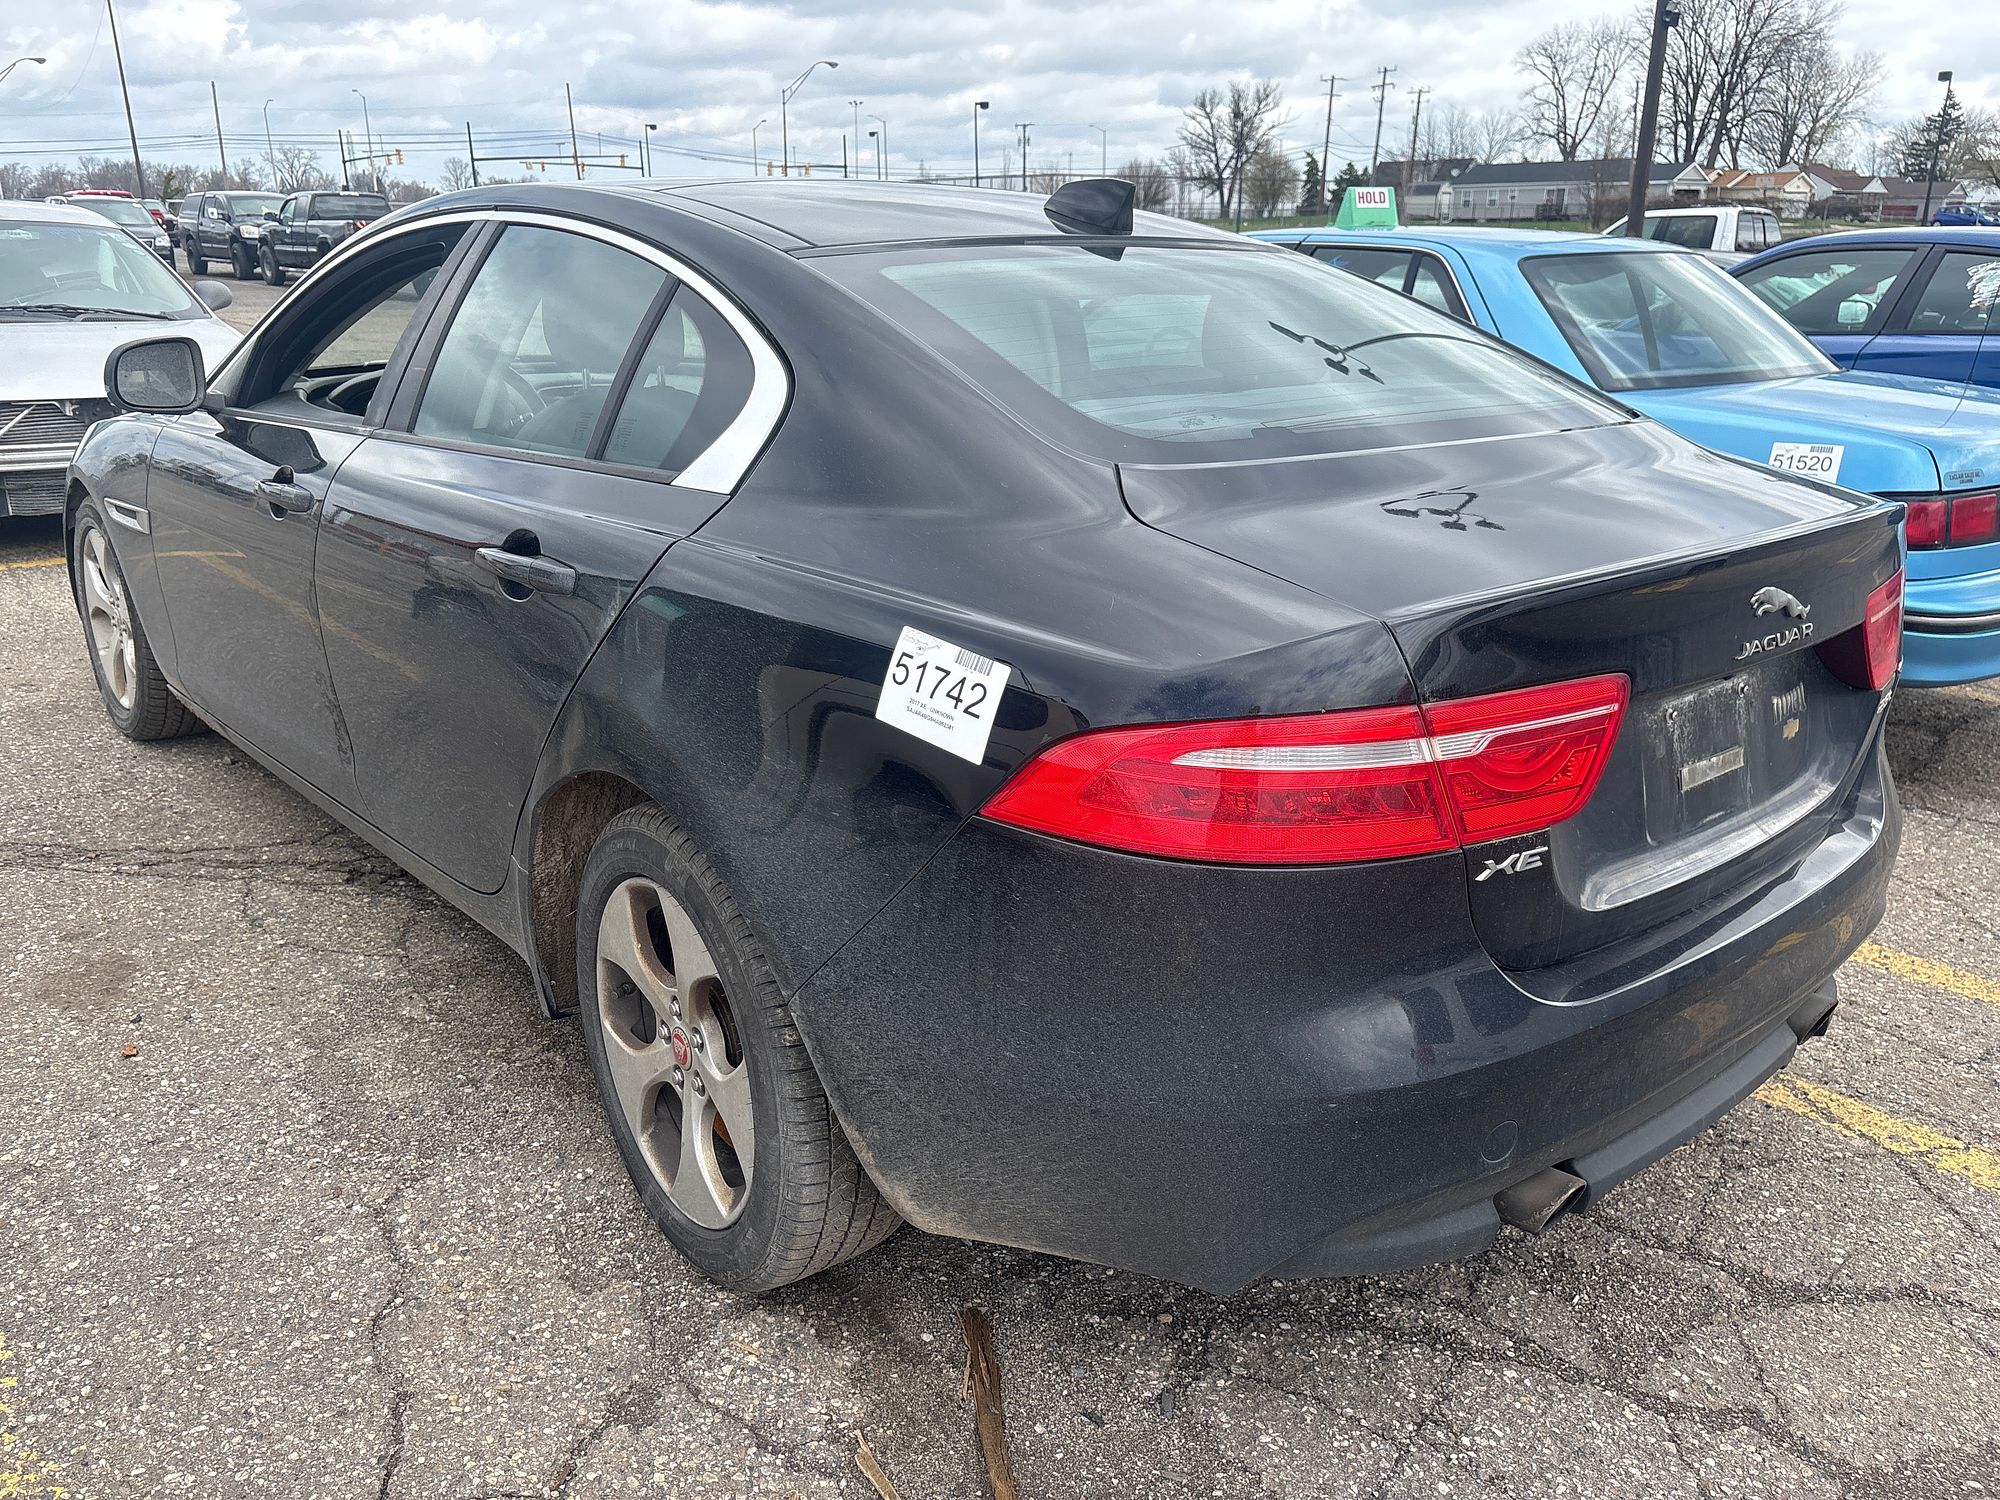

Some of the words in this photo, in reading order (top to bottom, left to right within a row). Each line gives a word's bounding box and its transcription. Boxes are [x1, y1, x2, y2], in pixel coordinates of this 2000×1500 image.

[1357, 191, 1386, 204] HOLD
[1772, 454, 1833, 472] 51520
[1735, 622, 1814, 660] JAGUAR
[892, 651, 988, 719] 51742
[909, 697, 921, 706] 2017
[929, 706, 955, 722] UNKNOWN
[1474, 846, 1549, 881] XE
